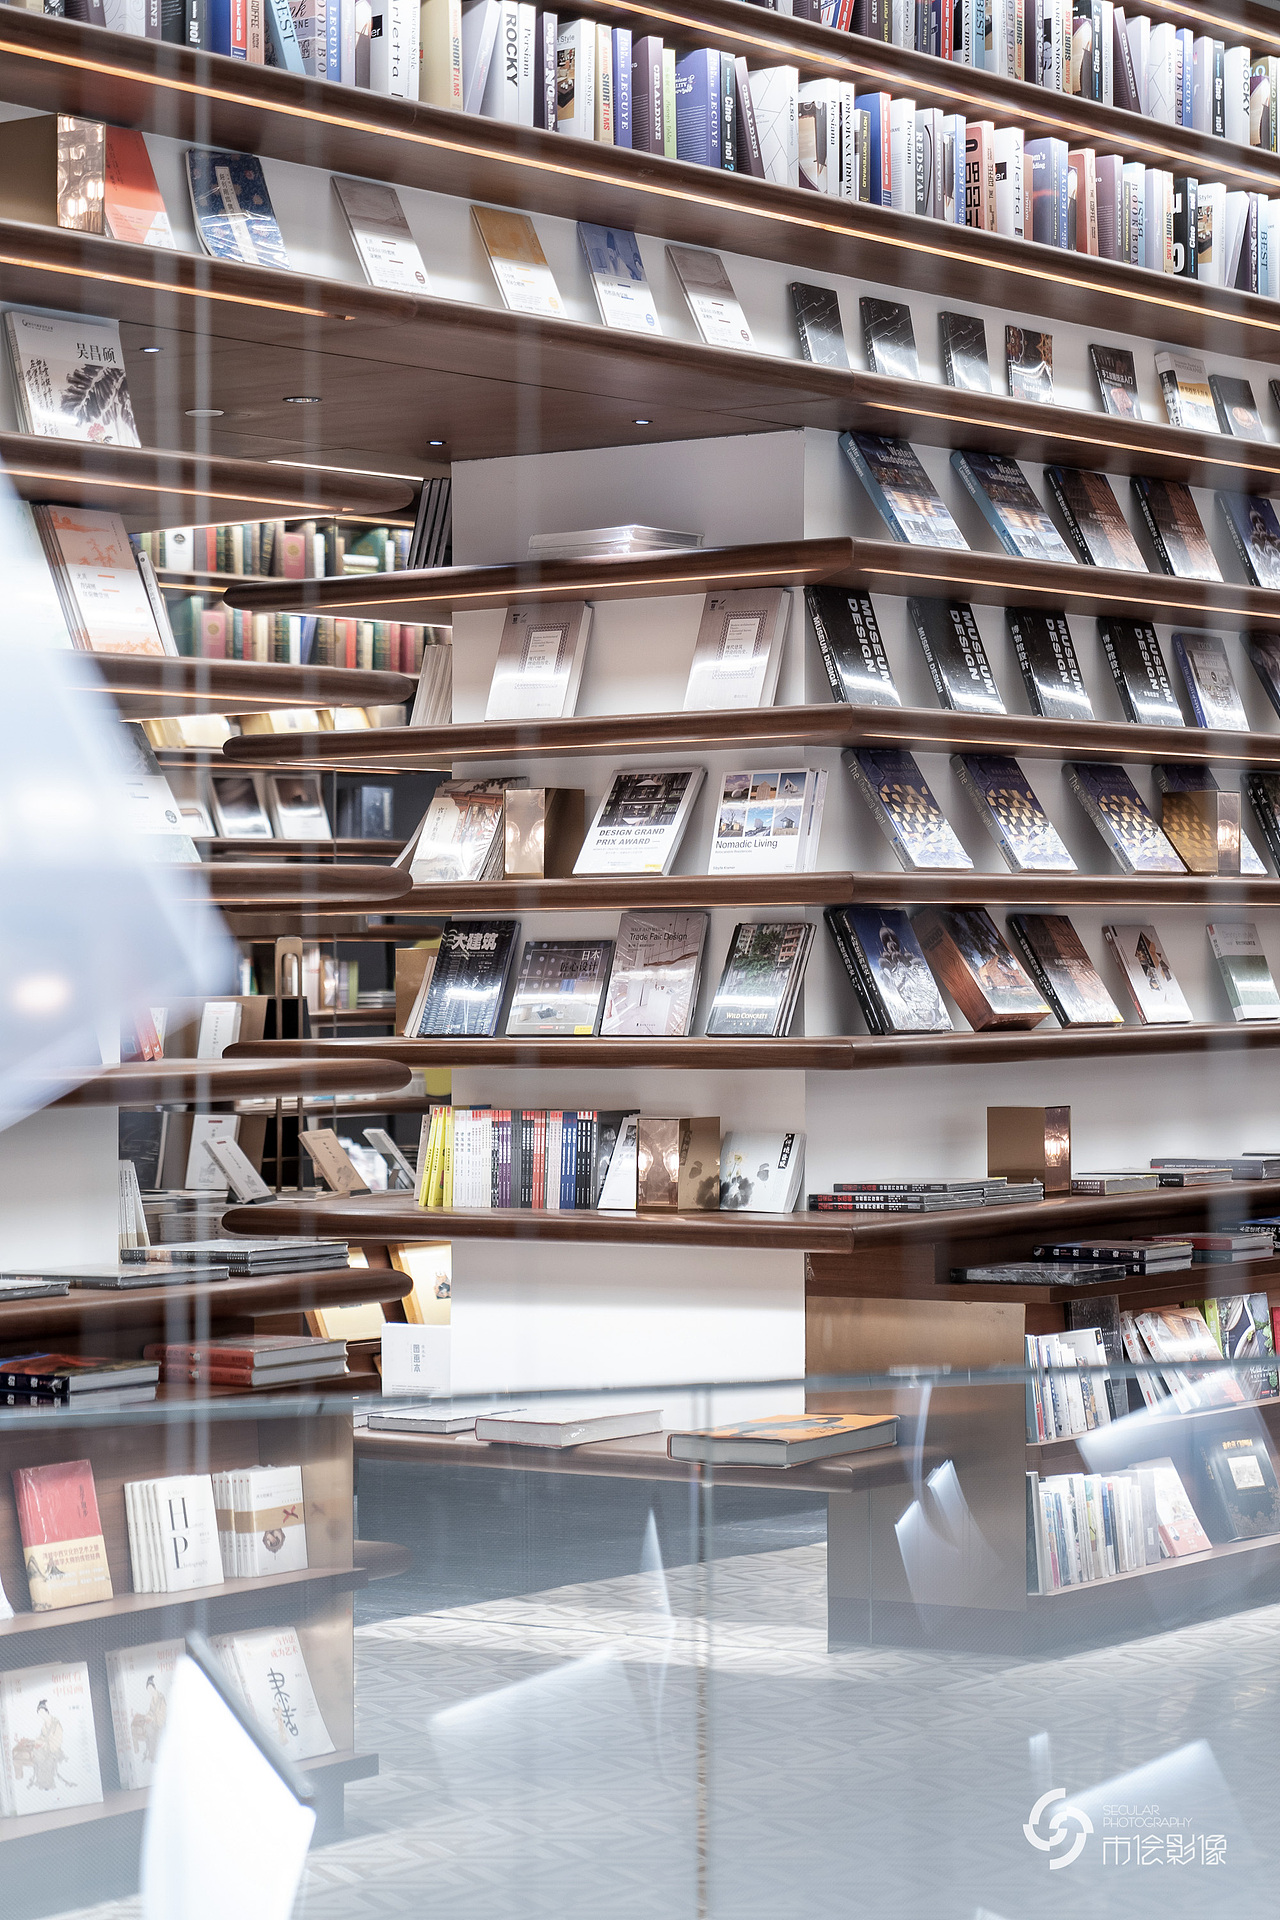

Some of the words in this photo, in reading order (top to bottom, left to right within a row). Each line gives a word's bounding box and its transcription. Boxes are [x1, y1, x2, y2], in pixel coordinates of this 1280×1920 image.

[506, 13, 519, 87] ROCKY
[975, 0, 985, 41] BEST
[1242, 57, 1251, 117] ROCKY
[916, 131, 924, 202] REDSTAR
[76, 342, 117, 364] 吴昌硕
[876, 452, 920, 468] Landscapes
[887, 446, 914, 459] Water
[812, 616, 830, 655] MUSEUM
[823, 655, 837, 687] DESIGN
[848, 598, 877, 674] DESIGN
[859, 599, 893, 687] MUSEUM
[917, 626, 933, 663] MUSEUM
[929, 663, 944, 694] DESIGN
[950, 609, 980, 681] DESIGN
[961, 611, 997, 695] MUSEUM
[1045, 618, 1070, 684] DESIGN
[1057, 619, 1084, 696] MUSEUM
[1133, 627, 1159, 691] DESIGN
[1144, 629, 1174, 703] MUSEUM
[849, 761, 860, 780] The
[874, 806, 886, 825] Night
[956, 766, 968, 785] The
[981, 810, 993, 828] Night
[1068, 773, 1080, 792] The
[598, 829, 633, 837] DESIGN
[634, 828, 665, 836] GRAND
[715, 839, 752, 849] Nomadic
[753, 839, 778, 850] Living
[559, 961, 599, 972] 匠心设计
[582, 950, 601, 961] 日本
[630, 932, 648, 941] Trade
[649, 932, 662, 941] Fair
[663, 932, 688, 943] Design
